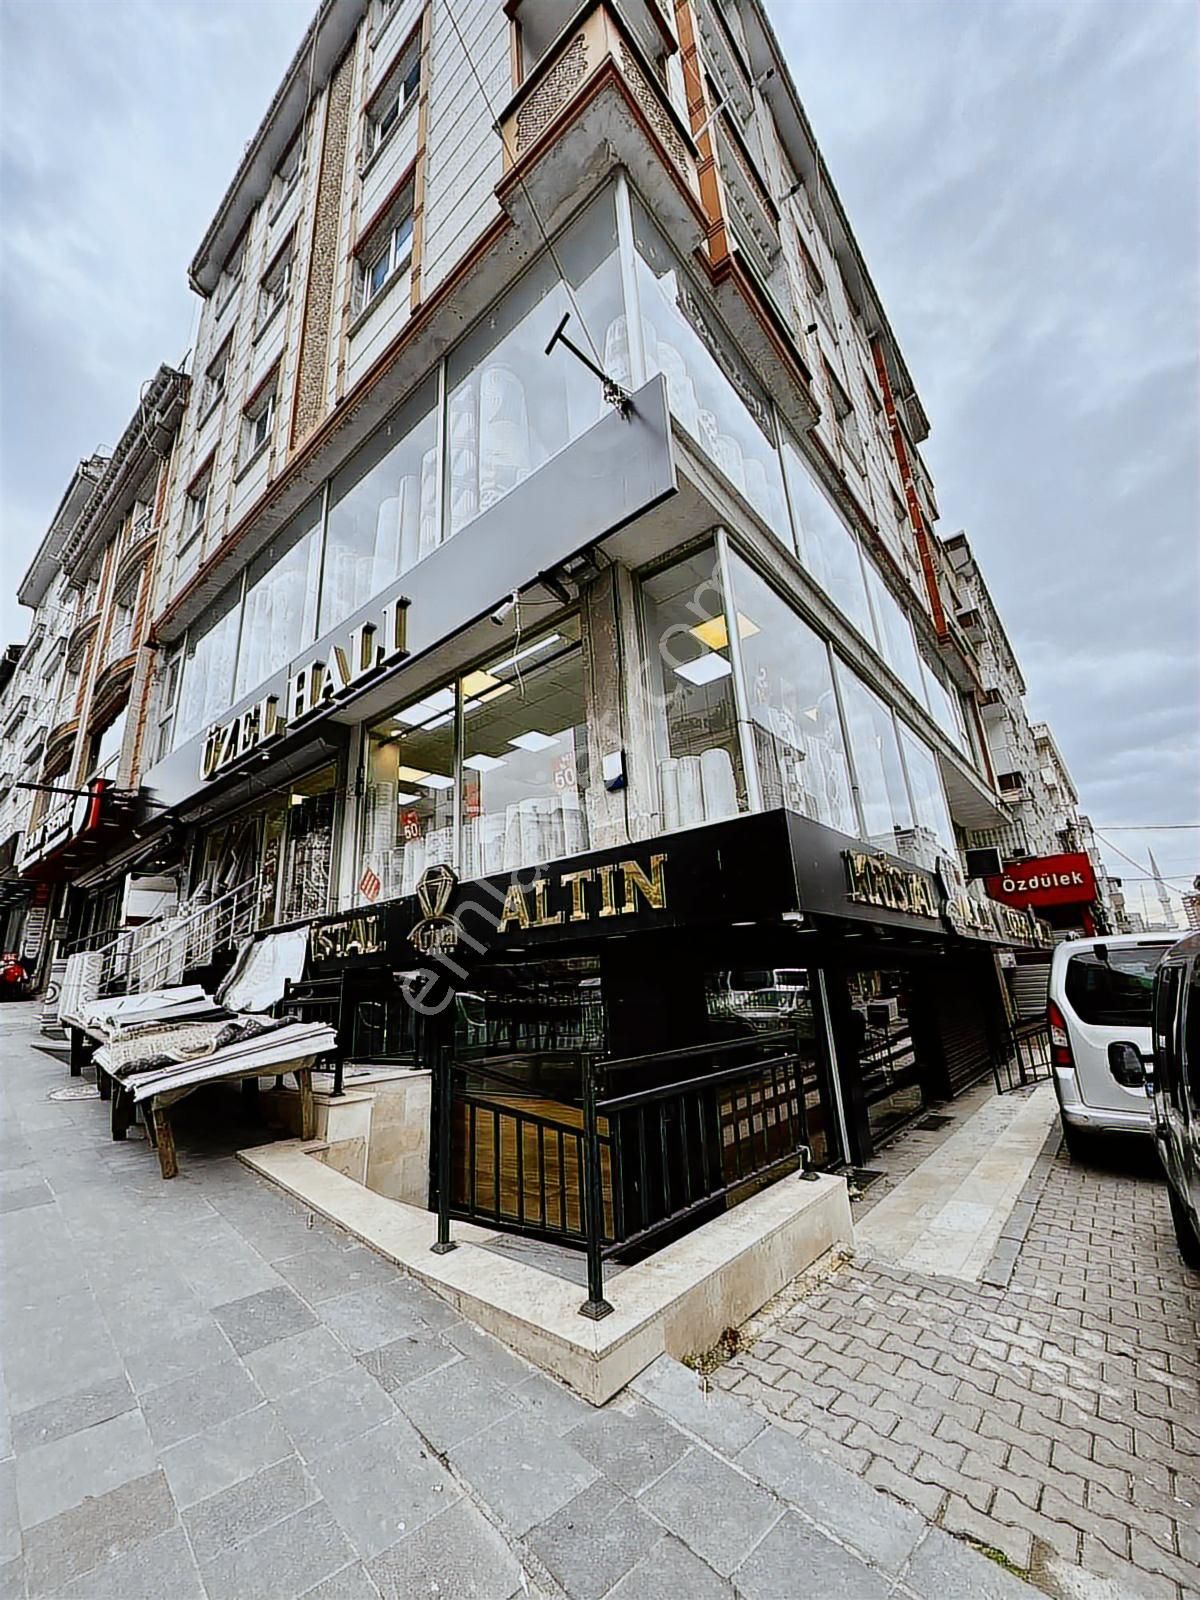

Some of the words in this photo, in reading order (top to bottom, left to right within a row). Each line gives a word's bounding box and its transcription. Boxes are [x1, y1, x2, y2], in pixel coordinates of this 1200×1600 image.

[285, 596, 412, 729] HALI
[497, 854, 668, 933] ALTIN
[1002, 871, 1084, 893] Özdülek
